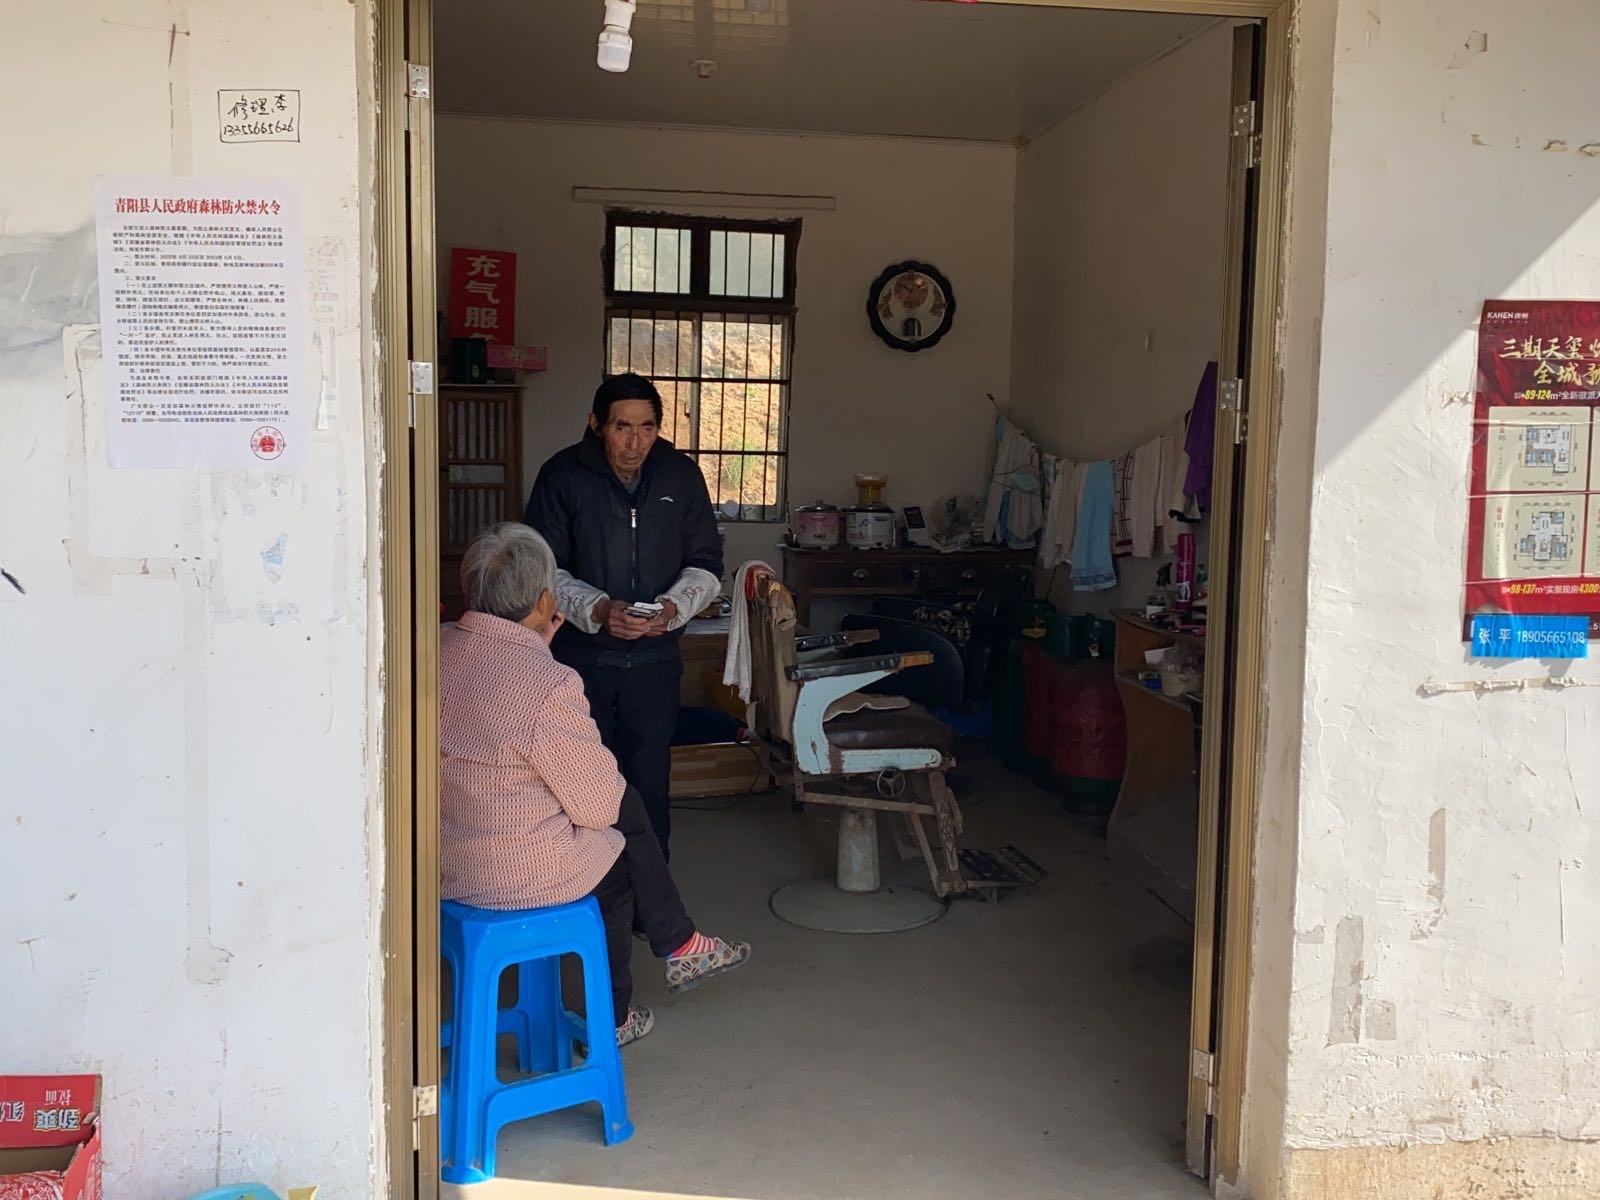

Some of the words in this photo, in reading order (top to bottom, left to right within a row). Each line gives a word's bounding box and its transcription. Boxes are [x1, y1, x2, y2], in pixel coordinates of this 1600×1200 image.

[223, 117, 294, 137] 13355665626
[114, 197, 281, 215] 青阳县人民政府森林防火禁火令
[1499, 335, 1584, 360] 三期天玺
[1517, 630, 1586, 644] 18905665108
[33, 1107, 81, 1132] 劲爽
